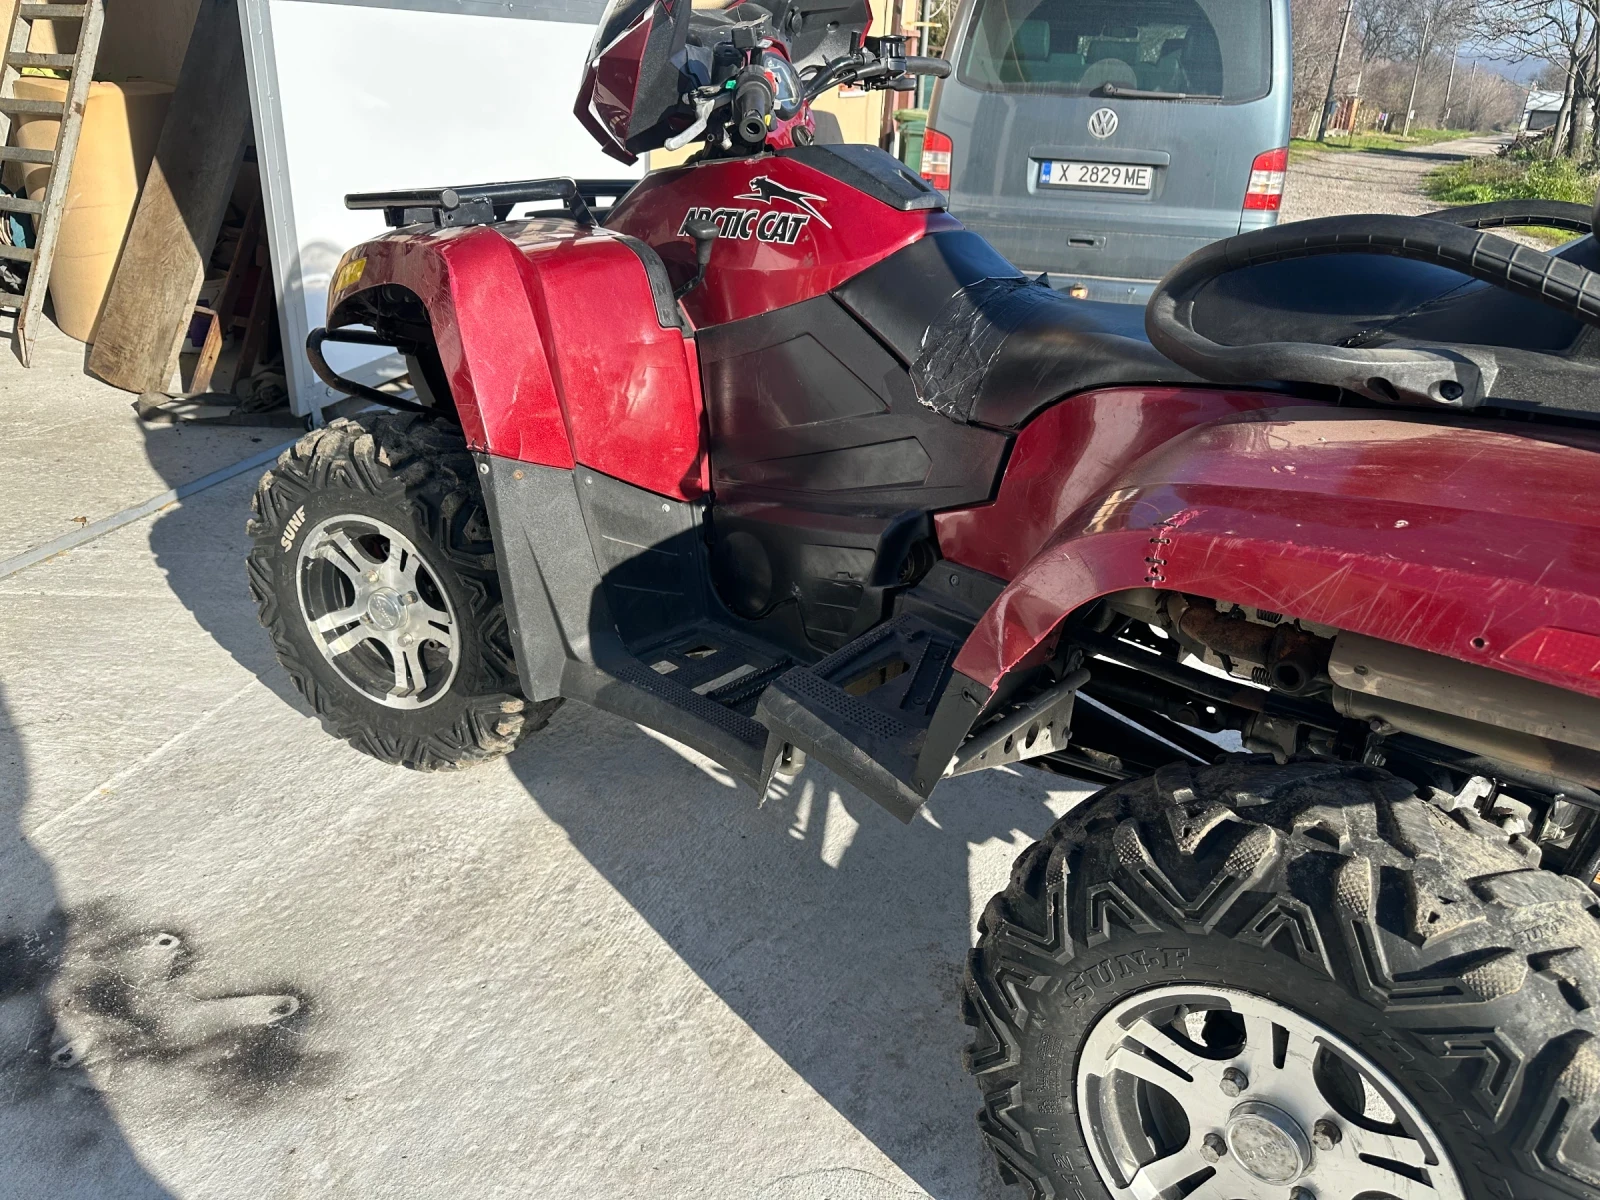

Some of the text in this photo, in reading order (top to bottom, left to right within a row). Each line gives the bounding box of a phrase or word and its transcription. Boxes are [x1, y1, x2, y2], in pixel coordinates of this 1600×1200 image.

[1059, 164, 1070, 182] X
[1078, 165, 1121, 184] 2829
[1124, 168, 1148, 186] ME
[756, 211, 811, 244] CAT
[280, 504, 306, 553] SUNF
